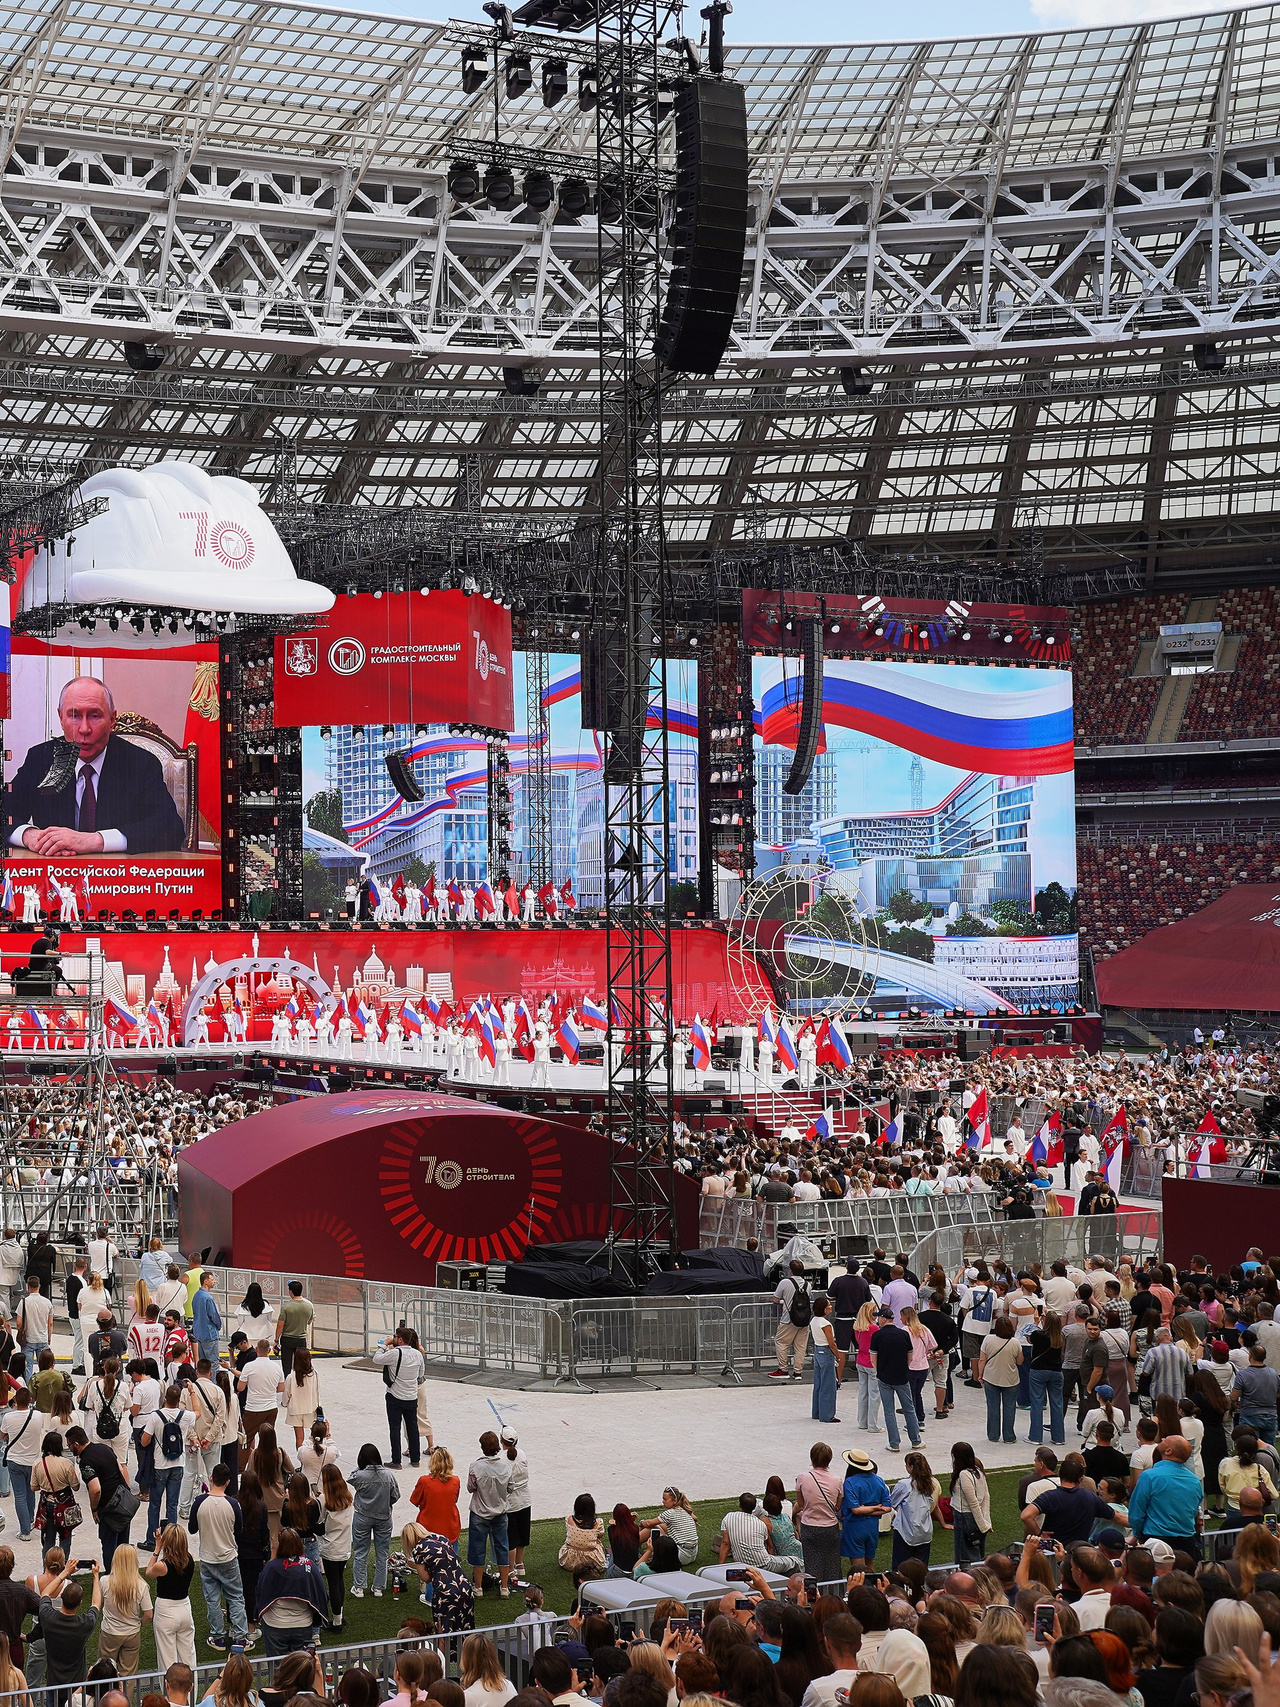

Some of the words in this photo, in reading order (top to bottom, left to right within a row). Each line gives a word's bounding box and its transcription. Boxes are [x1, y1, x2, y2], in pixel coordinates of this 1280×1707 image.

[178, 511, 255, 570] 70
[370, 642, 461, 655] ГРАДОСТРОИТЕЛЬНЫЙ
[370, 655, 417, 664] КОМПЛЕКС
[418, 653, 457, 662] МОСКВЫ
[47, 864, 126, 877] Российской
[129, 865, 205, 879] Федерации
[88, 885, 151, 897] имирович
[155, 882, 193, 897] Путин
[419, 1156, 463, 1190] 70
[145, 1337, 160, 1352] 12
